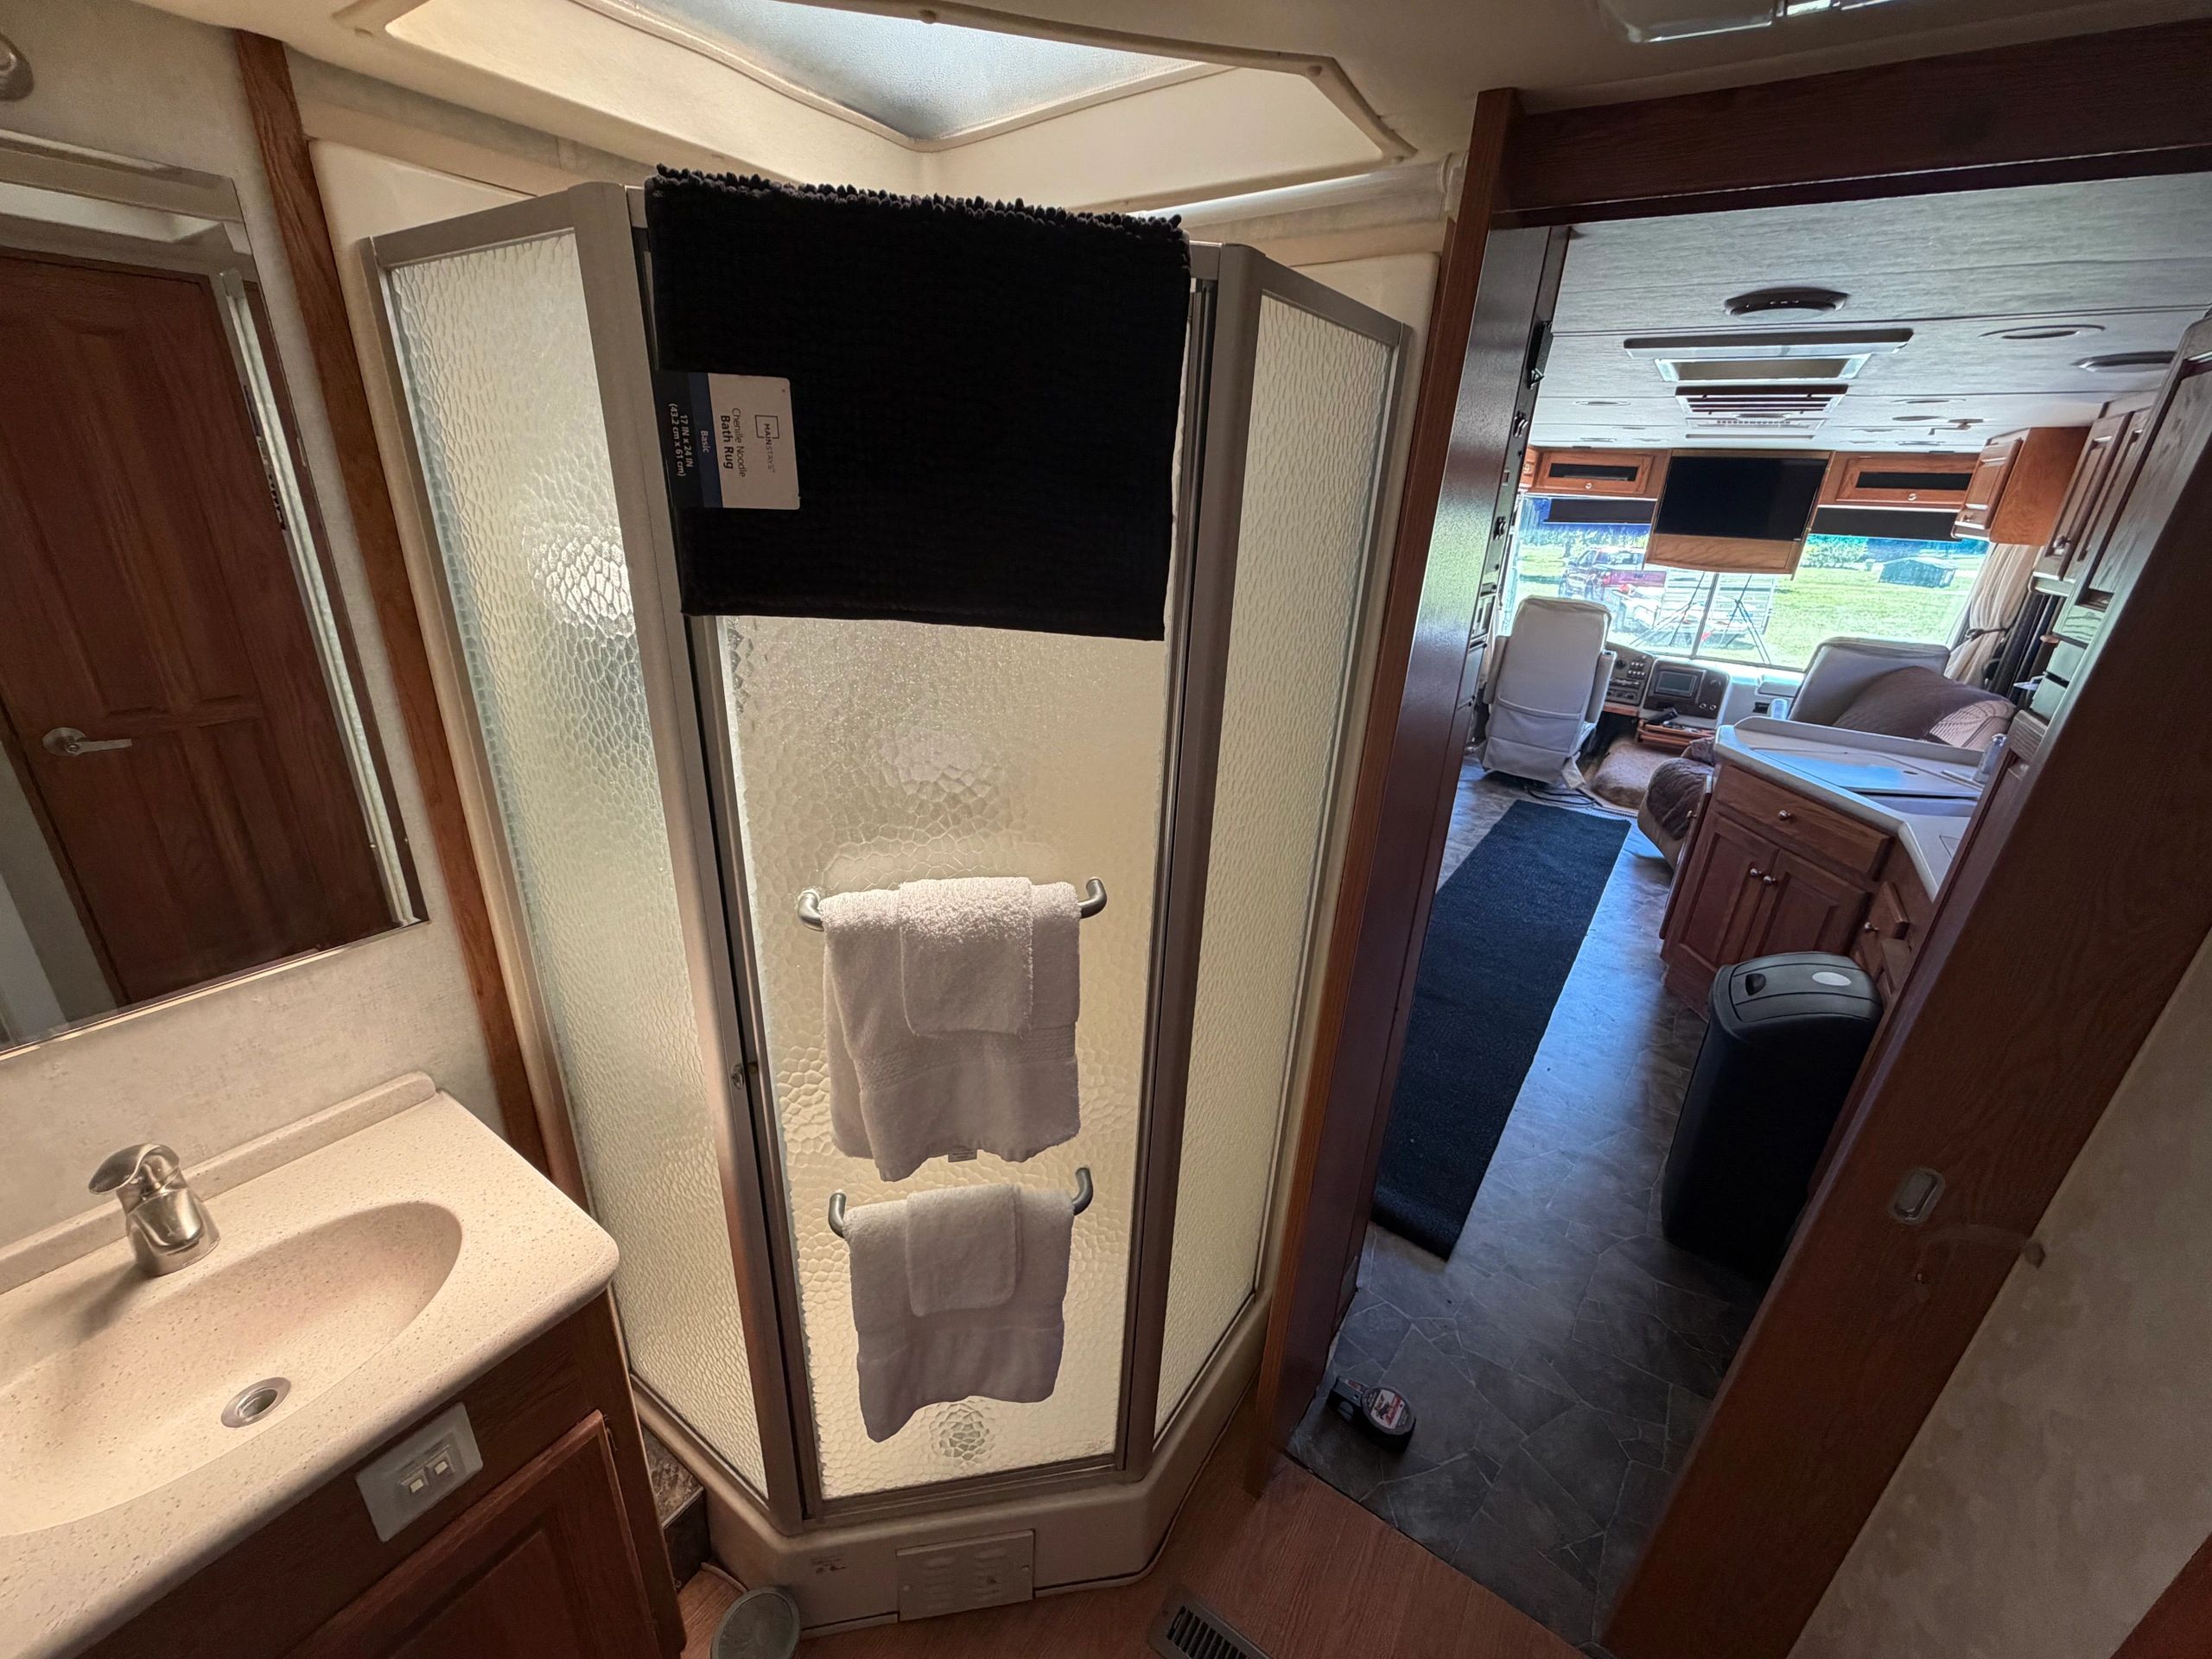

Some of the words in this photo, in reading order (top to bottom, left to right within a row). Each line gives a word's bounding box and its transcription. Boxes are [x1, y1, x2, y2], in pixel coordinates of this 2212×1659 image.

[668, 404, 679, 425] (43.2
[680, 415, 688, 423] 17
[672, 428, 679, 439] cm
[721, 415, 733, 443] Bath
[732, 408, 743, 443] Chenille
[683, 445, 692, 456] 24
[700, 430, 710, 453] Basic
[675, 449, 683, 460] 61
[686, 459, 694, 467] IN
[723, 447, 734, 469] Rug
[736, 446, 747, 477] Noodle
[677, 461, 686, 477] cm)
